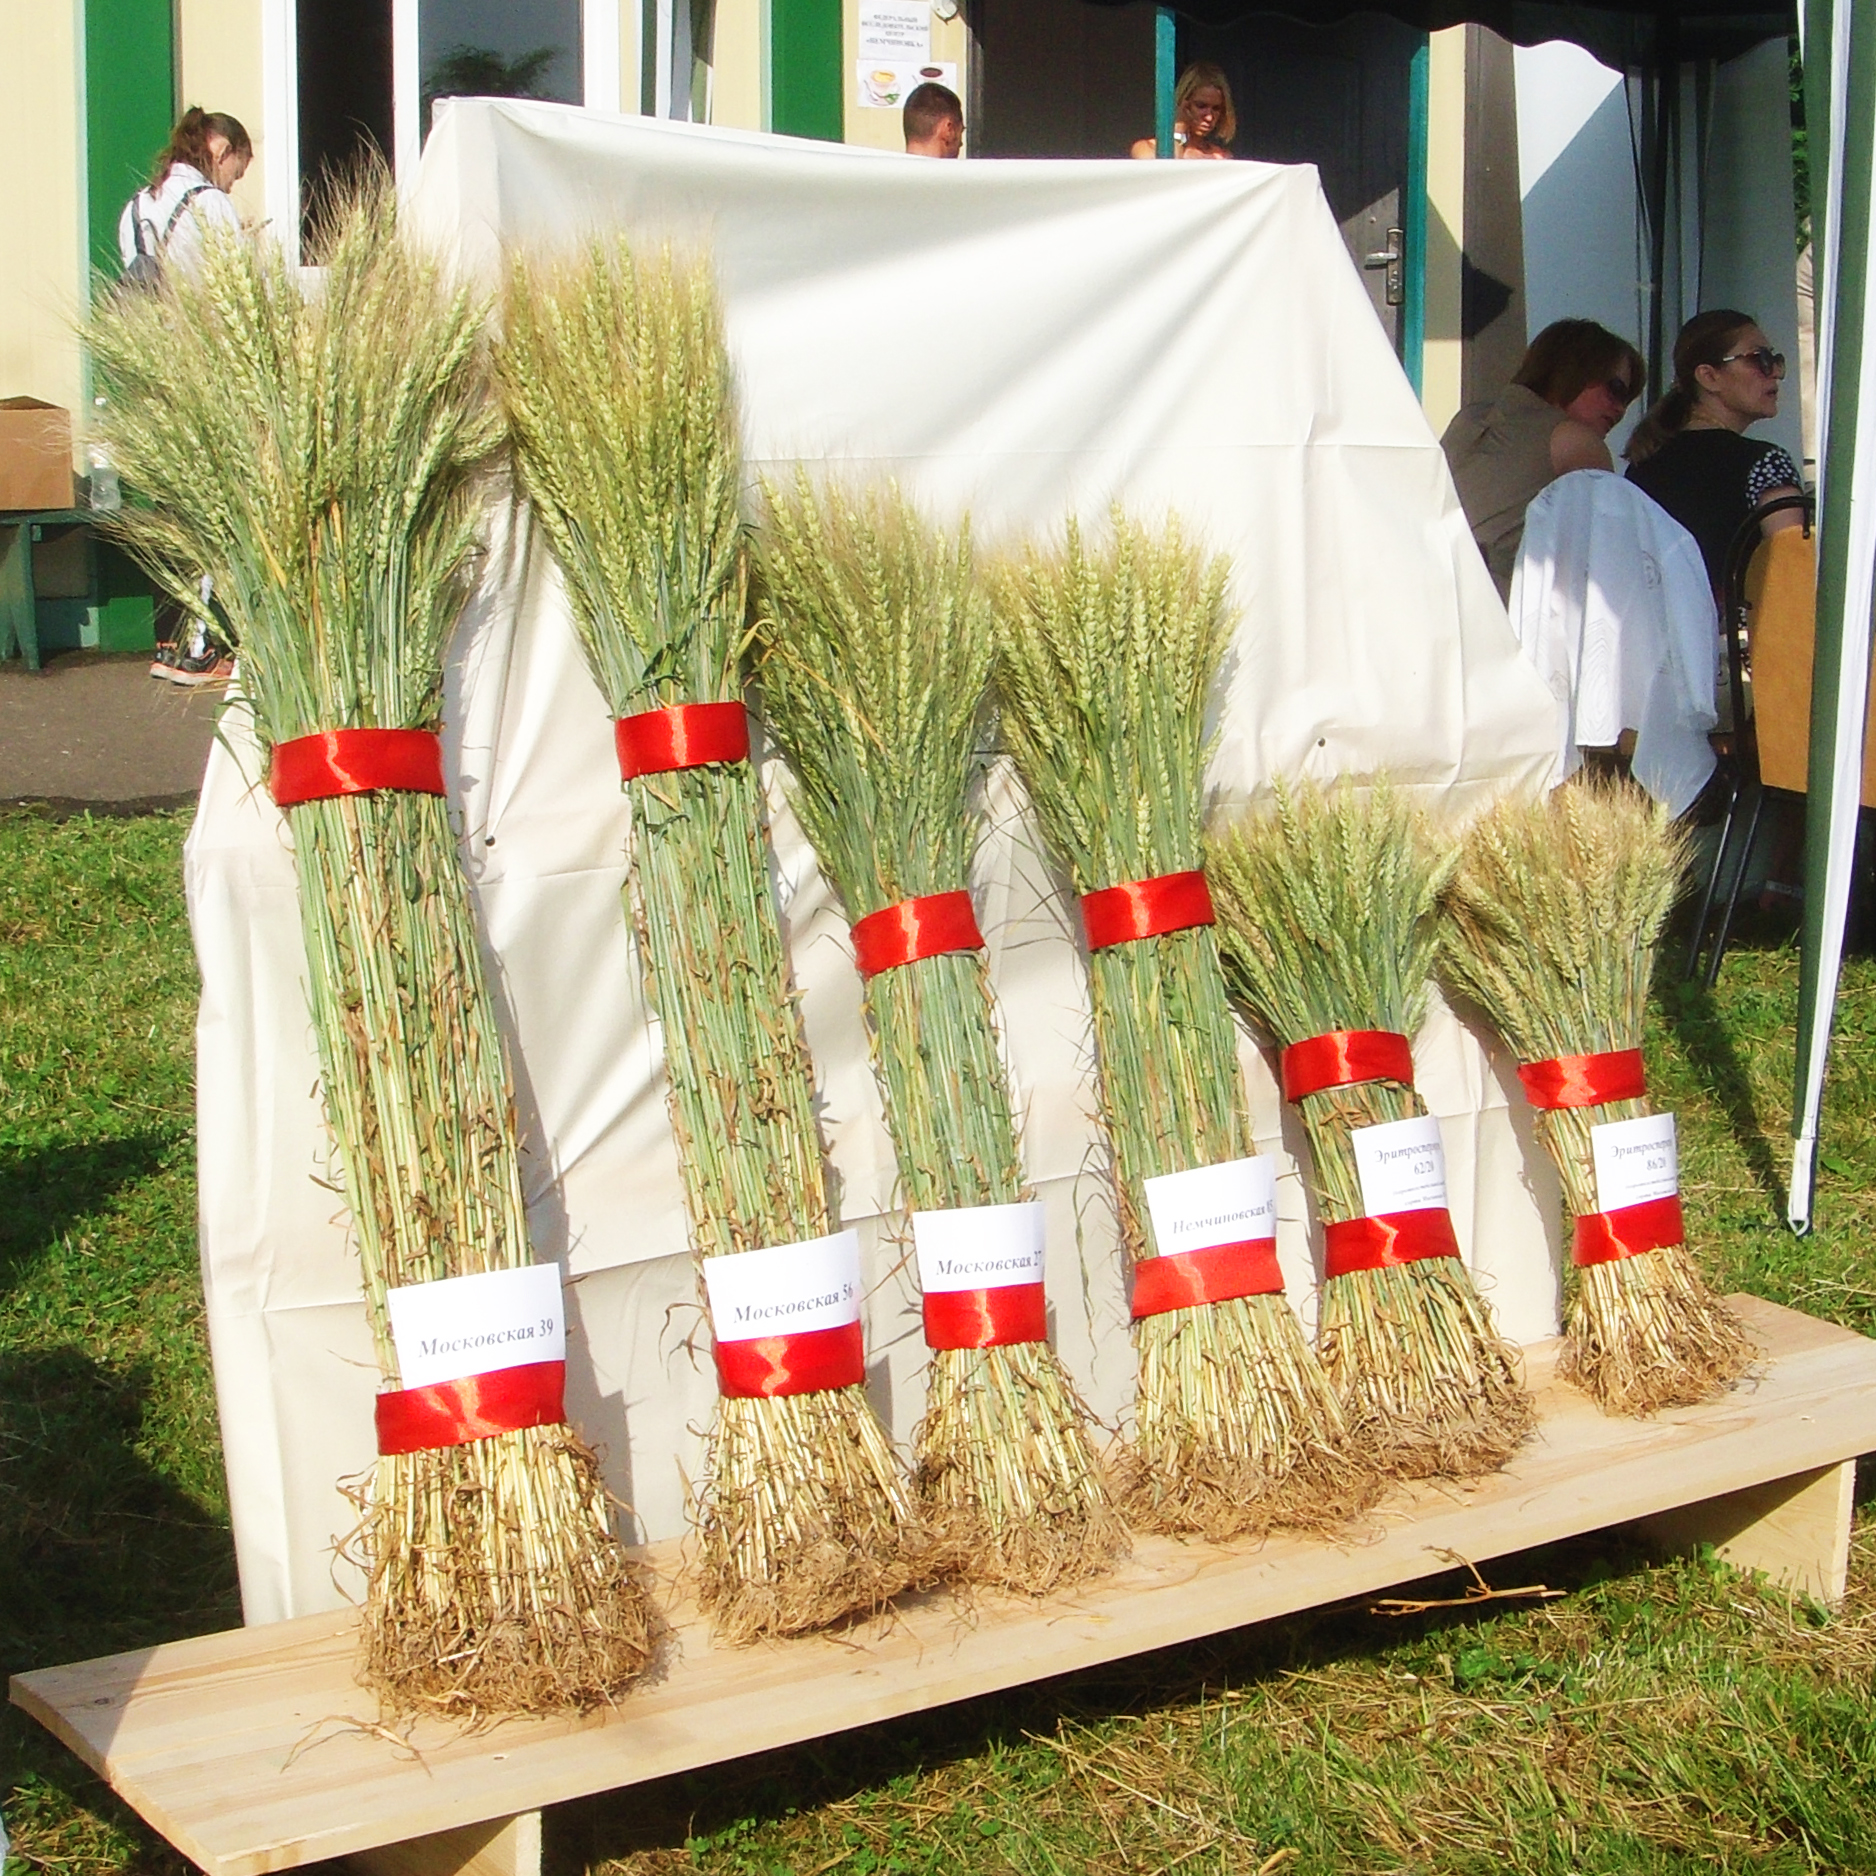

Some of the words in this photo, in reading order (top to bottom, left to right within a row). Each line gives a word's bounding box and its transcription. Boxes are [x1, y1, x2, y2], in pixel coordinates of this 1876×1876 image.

[1172, 1205, 1266, 1235] Немчиновская
[936, 1256, 1032, 1276] Московская
[733, 1292, 840, 1324] Московская
[842, 1281, 854, 1302] 56
[418, 1325, 535, 1359] Московская
[539, 1318, 555, 1338] 39
